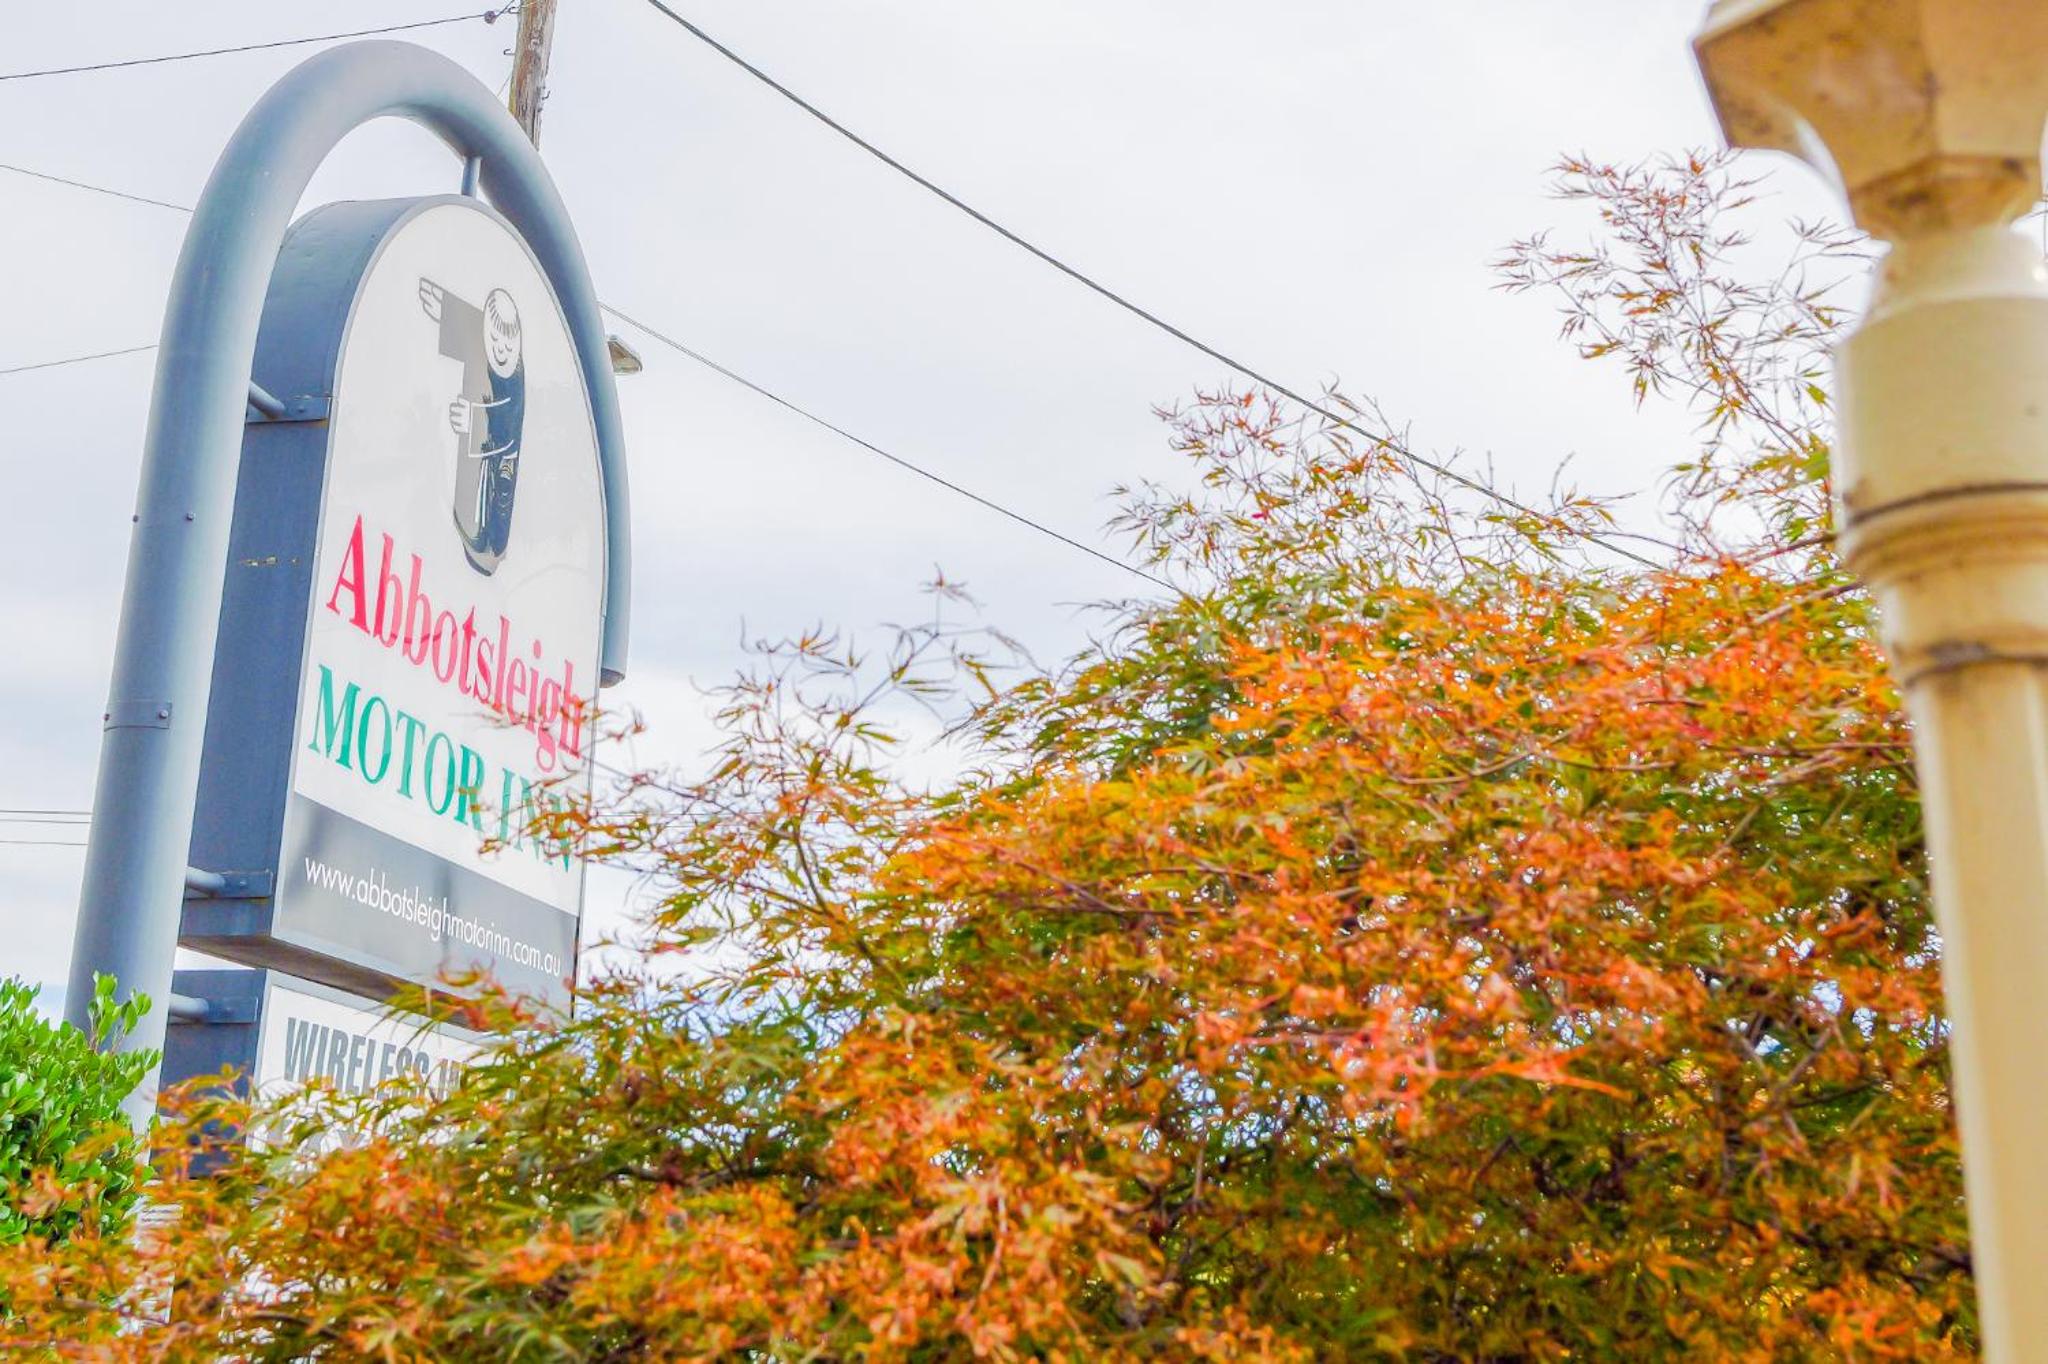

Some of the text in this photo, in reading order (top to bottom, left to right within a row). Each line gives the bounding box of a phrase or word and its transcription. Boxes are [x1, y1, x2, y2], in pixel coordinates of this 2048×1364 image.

[326, 513, 582, 773] Abbotsleigh
[308, 663, 485, 833] MOTOR
[304, 857, 562, 976] www.abbotsleighmotorinn.com.au
[284, 1016, 431, 1101] WIRELESS
